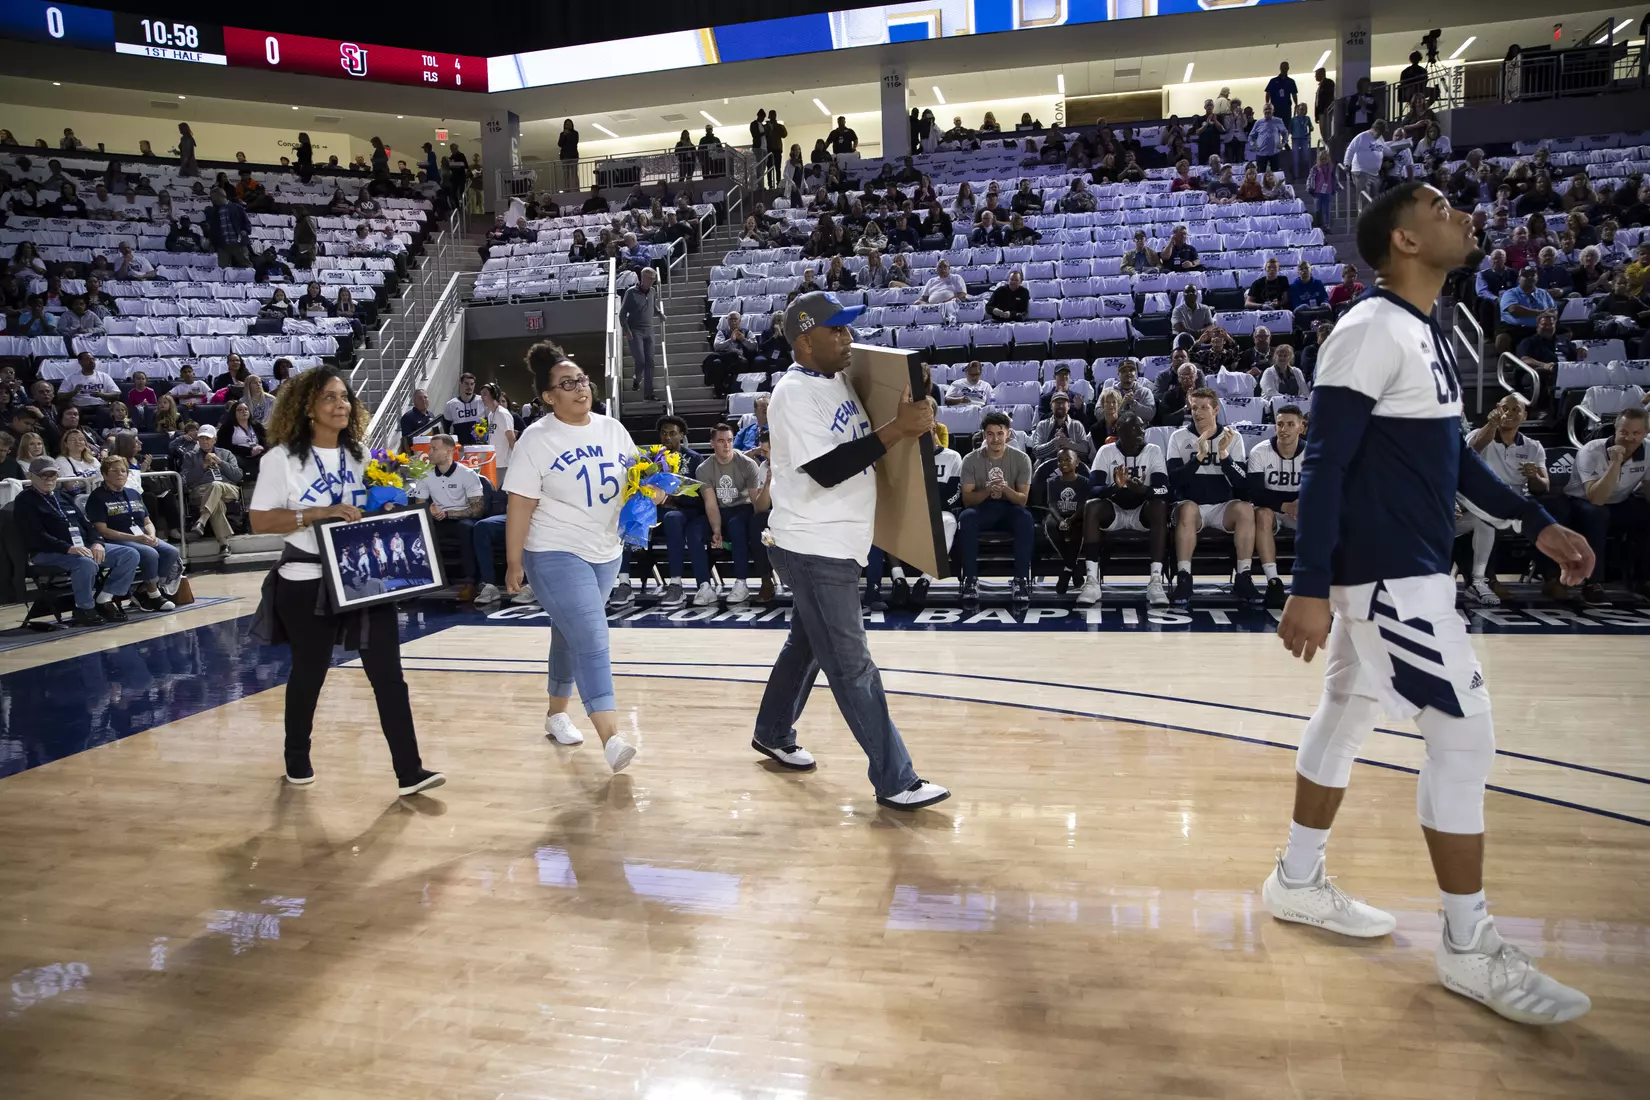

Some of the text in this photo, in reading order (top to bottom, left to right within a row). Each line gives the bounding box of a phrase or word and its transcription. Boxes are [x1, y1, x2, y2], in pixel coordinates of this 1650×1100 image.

[46, 7, 65, 39] 0
[141, 19, 199, 48] 10:58
[144, 47, 203, 62] 1ST HALF
[265, 36, 280, 65] 0
[421, 54, 461, 70] TOL 4
[423, 71, 461, 86] FLS 0
[277, 140, 320, 149] Concens
[800, 318, 816, 332] 1937
[458, 408, 478, 418] CBU
[831, 400, 860, 434] TEAM
[550, 445, 604, 472] TEAM
[299, 470, 356, 503] TEAM
[576, 462, 620, 508] 15
[1268, 471, 1301, 486] CBU
[914, 608, 1238, 625] BAPTIST
